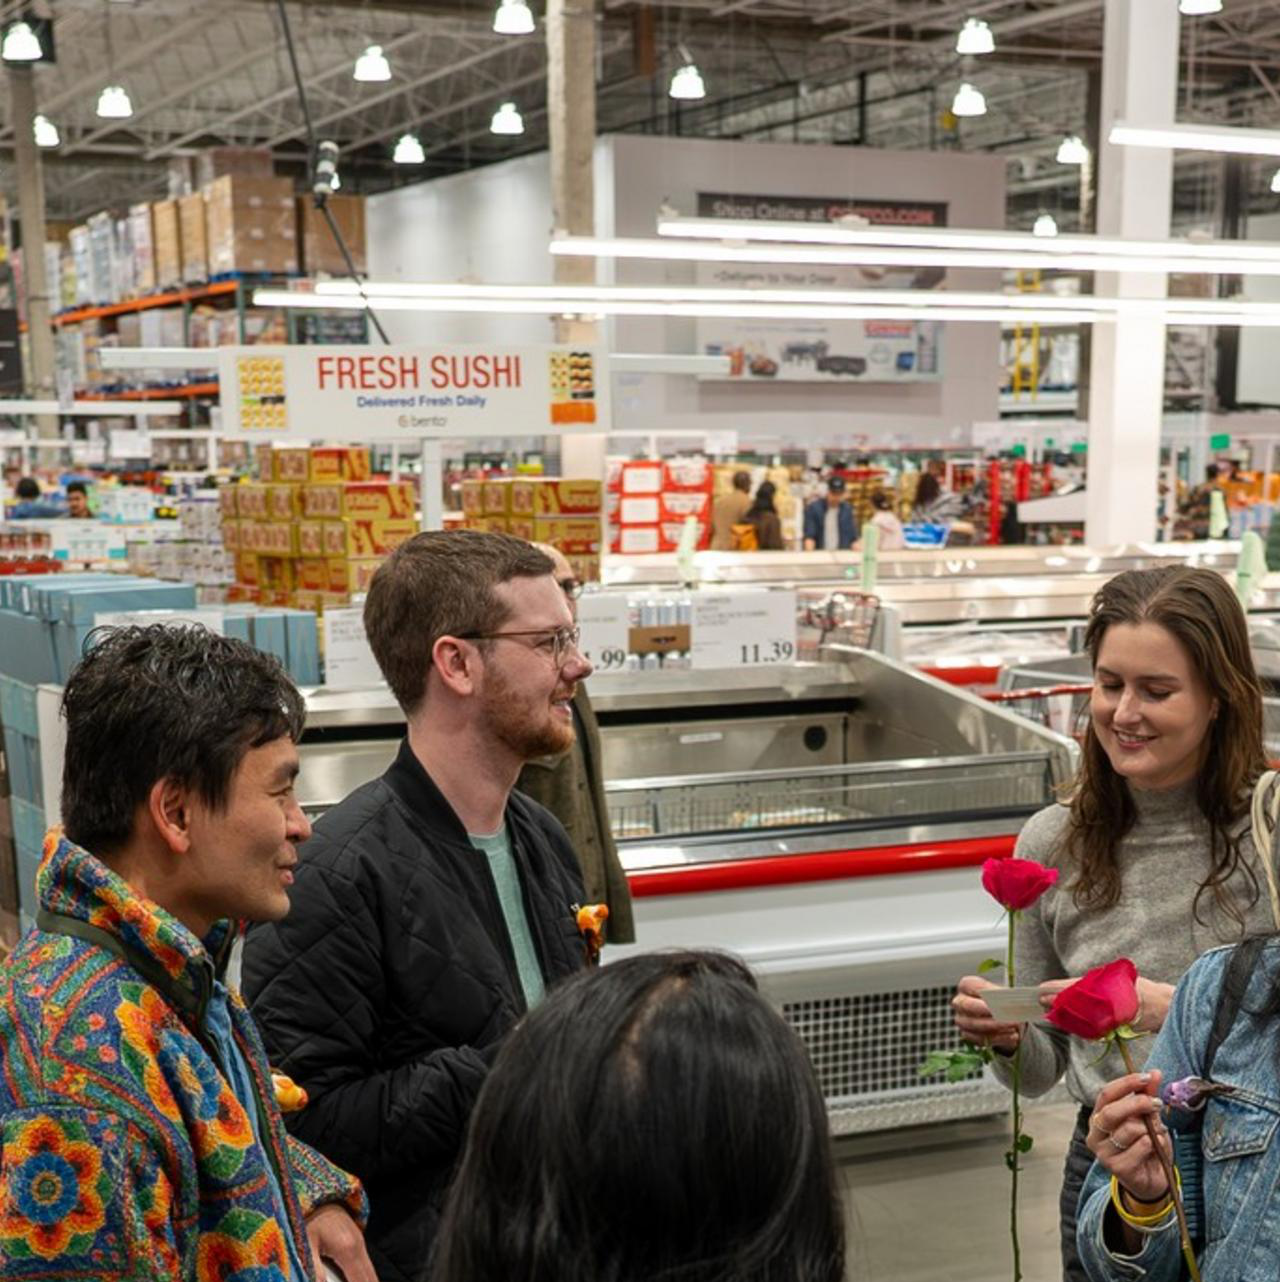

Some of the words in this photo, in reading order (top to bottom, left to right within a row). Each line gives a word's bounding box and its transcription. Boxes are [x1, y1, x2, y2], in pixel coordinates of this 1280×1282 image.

[756, 203, 806, 219] Online
[809, 205, 825, 220] at
[318, 356, 419, 390] FRESH
[430, 355, 522, 389] SUSHI
[357, 396, 416, 408] Delivered
[420, 395, 453, 407] Fresh
[456, 395, 487, 409] Daily
[741, 640, 793, 663] 11.39
